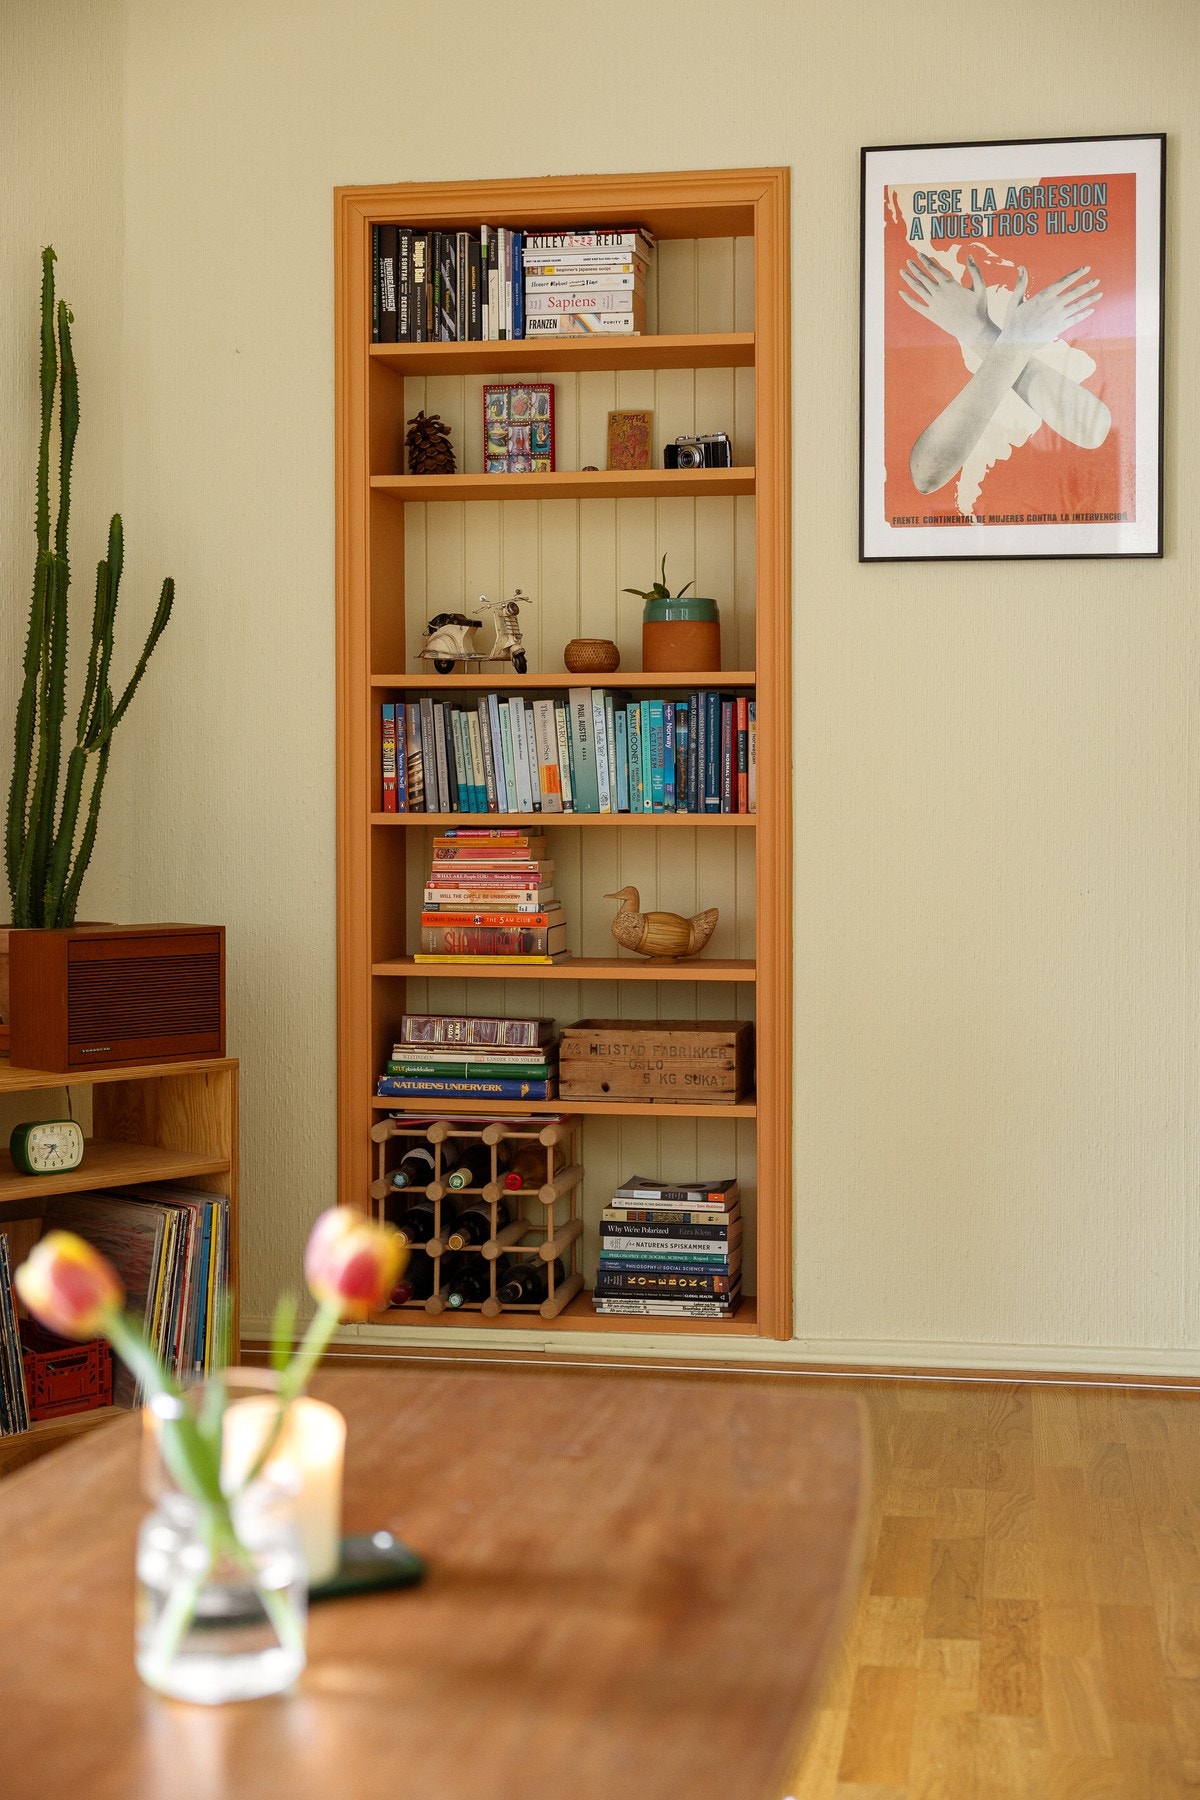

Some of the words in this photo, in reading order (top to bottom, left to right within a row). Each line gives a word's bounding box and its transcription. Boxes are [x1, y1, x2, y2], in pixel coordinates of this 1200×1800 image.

[913, 190, 962, 214] CESE
[971, 188, 997, 212] LA
[1005, 182, 1107, 210] AGRESION
[910, 217, 923, 240] A
[931, 212, 1038, 239] NUESTROS
[1046, 209, 1107, 234] HIJOS
[533, 236, 565, 248] KILEY
[596, 234, 622, 246] REID
[413, 241, 425, 267] Shuggie
[415, 268, 425, 283] Bain
[384, 257, 396, 312] HUNDREÅRINGEN
[548, 297, 596, 311] Sapiens
[529, 319, 557, 329] FRANZEN
[923, 515, 973, 523] CONTINENTAL
[383, 718, 395, 743] ZADIE
[558, 719, 566, 749] TAROT
[384, 747, 395, 773] SMITH
[444, 931, 525, 955] SHANTARAM
[567, 1043, 581, 1054] A/S
[590, 1043, 646, 1056] HEISTAD
[652, 1045, 727, 1058] FABRIKKER
[629, 1060, 664, 1070] OSLO
[393, 1081, 443, 1090] NATURENS
[445, 1082, 502, 1091] UNDERVERK
[643, 1074, 650, 1084] 5
[659, 1074, 677, 1084] KG
[684, 1074, 727, 1086] SUKAT
[628, 1277, 708, 1288] KOIEBOKA
